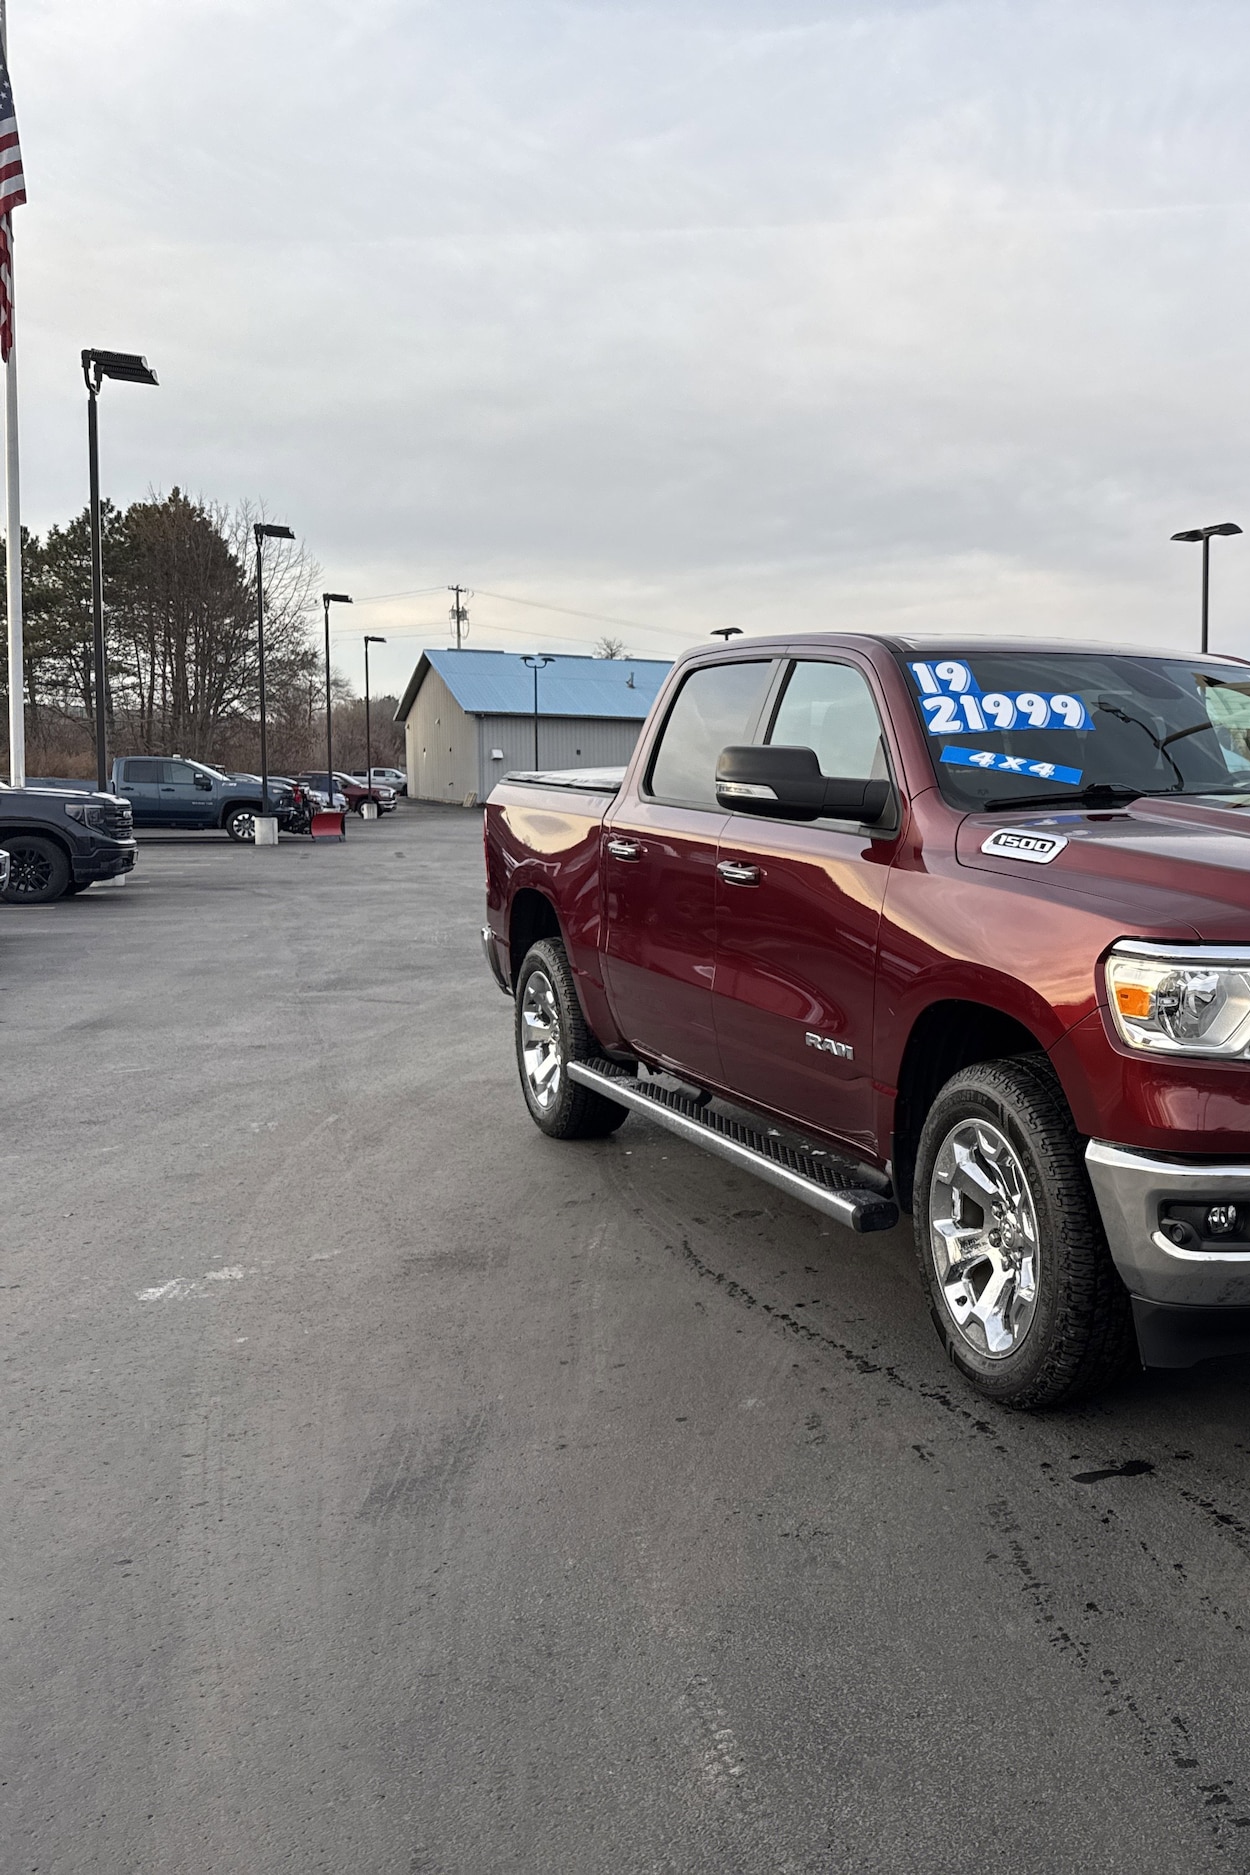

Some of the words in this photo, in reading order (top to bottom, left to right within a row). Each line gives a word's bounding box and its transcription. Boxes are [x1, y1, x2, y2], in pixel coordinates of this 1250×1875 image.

[912, 661, 972, 694] 19
[922, 692, 1085, 734] 21999
[998, 834, 1054, 852] 1500
[805, 1031, 854, 1061] RAM
